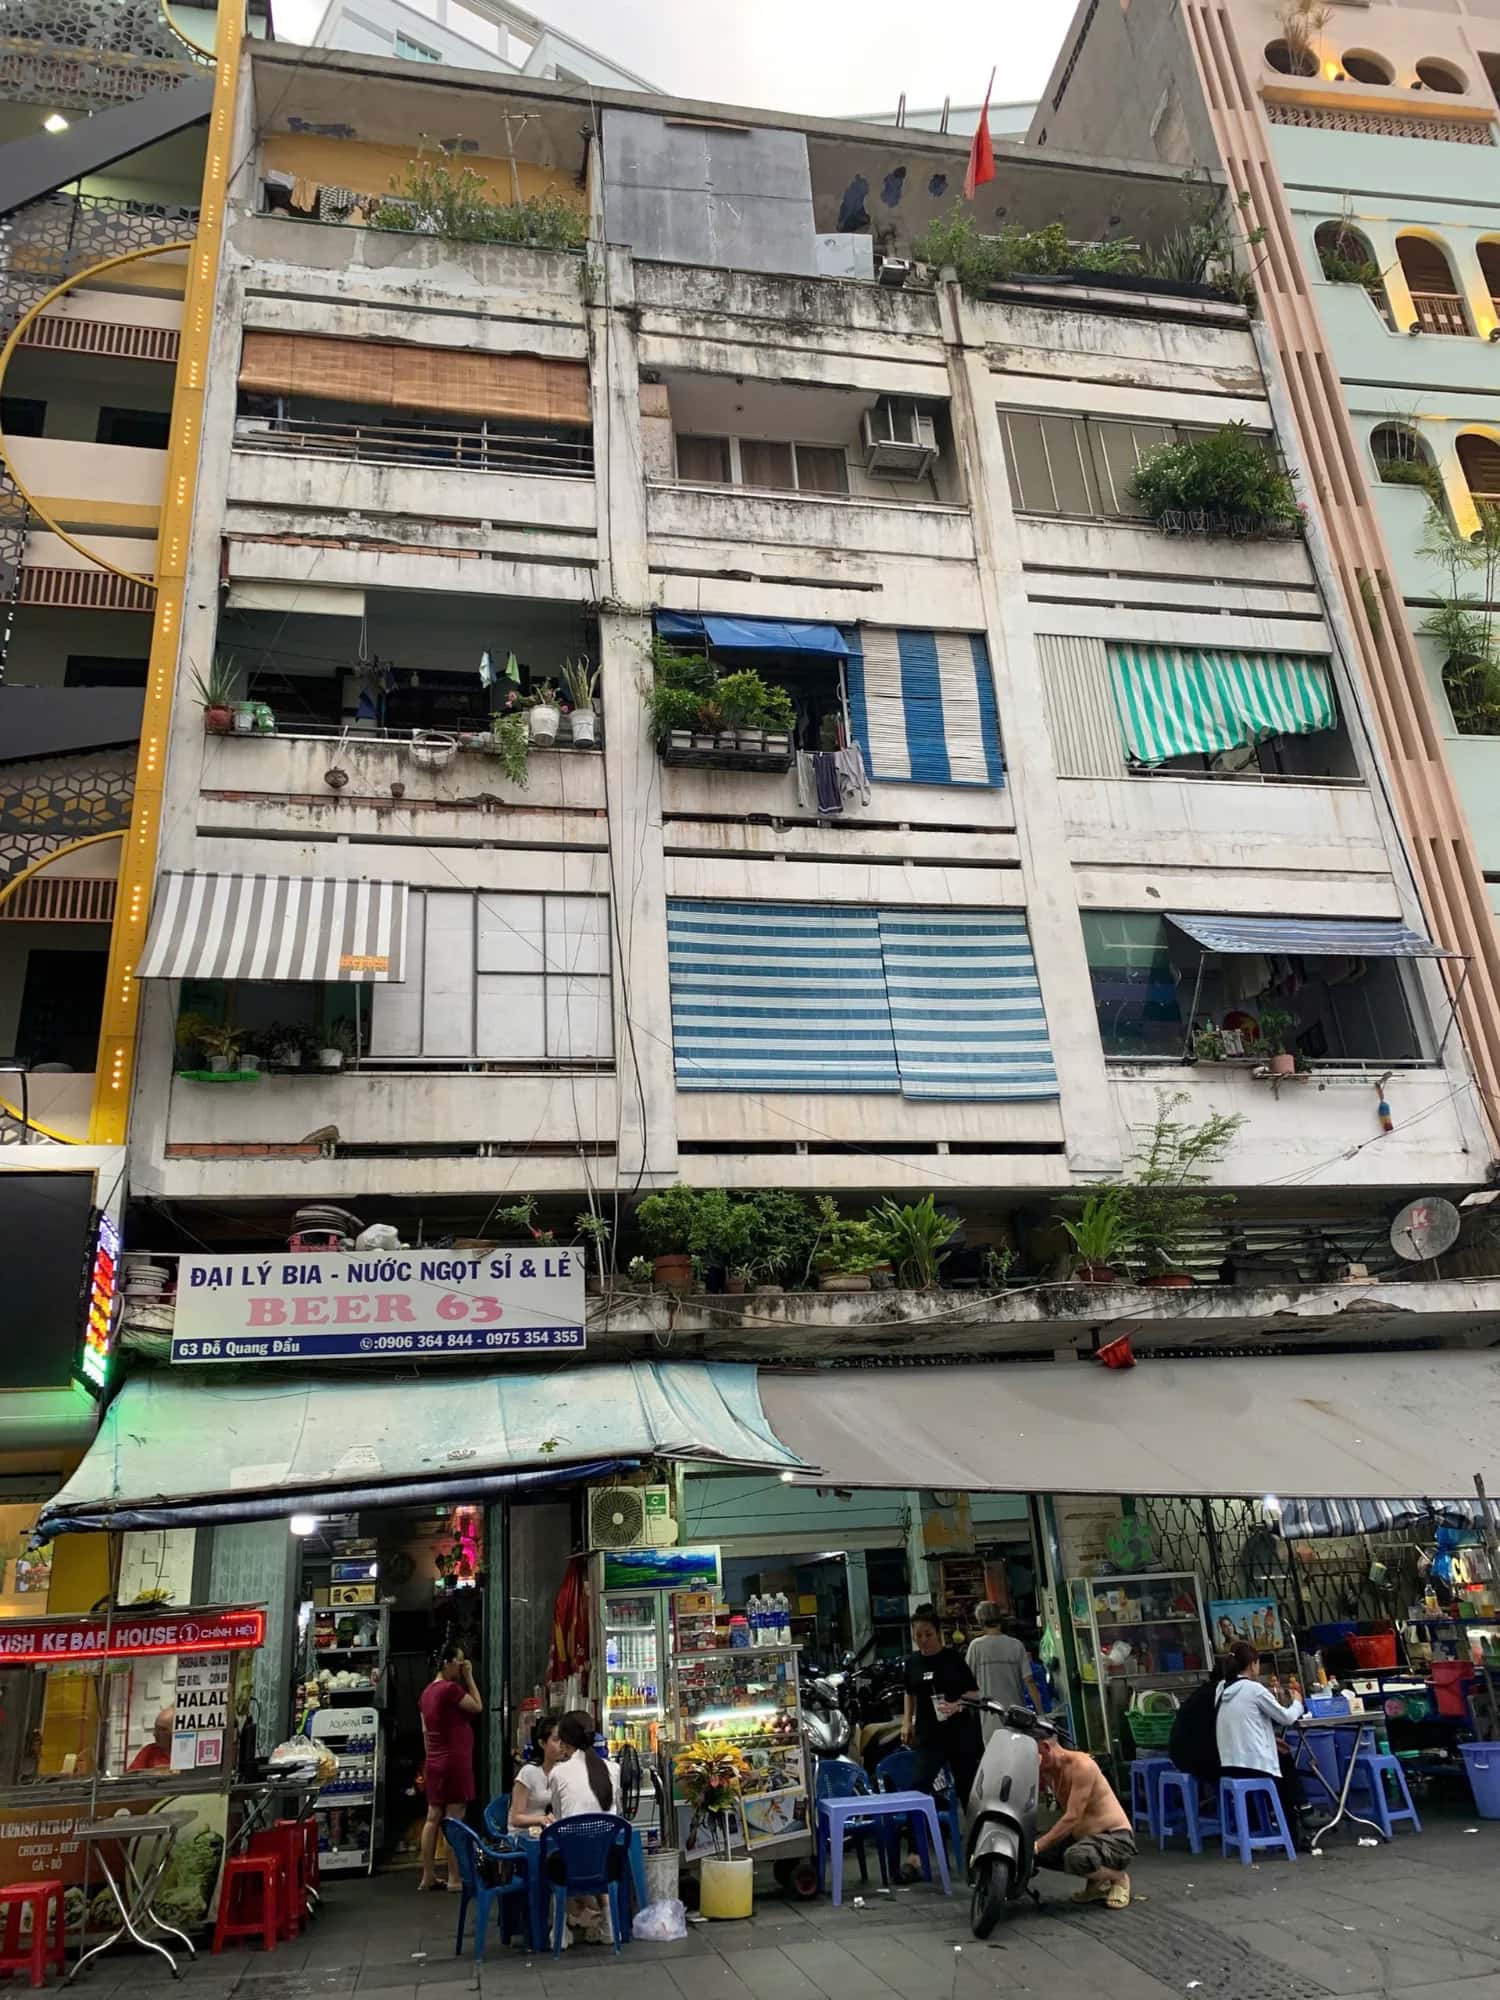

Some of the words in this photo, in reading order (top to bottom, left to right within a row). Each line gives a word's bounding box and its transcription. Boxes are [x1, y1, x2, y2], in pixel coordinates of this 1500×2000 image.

[190, 1266, 232, 1291] ĐẠI
[242, 1260, 272, 1286] LÝ
[282, 1264, 322, 1285] BIA
[347, 1257, 412, 1283] NƯỚC
[420, 1259, 481, 1285] NGỌT
[490, 1252, 512, 1279] SỈ
[519, 1258, 536, 1278] &
[545, 1251, 571, 1278] LẺ
[246, 1293, 416, 1327] BEER
[436, 1293, 503, 1324] 63
[179, 1342, 198, 1357] 63
[202, 1339, 221, 1355] Đỗ
[226, 1340, 269, 1356] Quang
[272, 1337, 300, 1354] Đẩu
[417, 1334, 442, 1348] 364
[447, 1333, 473, 1347] 844
[486, 1331, 520, 1346] 0975
[524, 1331, 549, 1345] 354
[553, 1330, 578, 1344] 355
[115, 1626, 178, 1649] HOUSE
[177, 1691, 227, 1708] HALAL
[175, 1712, 225, 1729] HALAL
